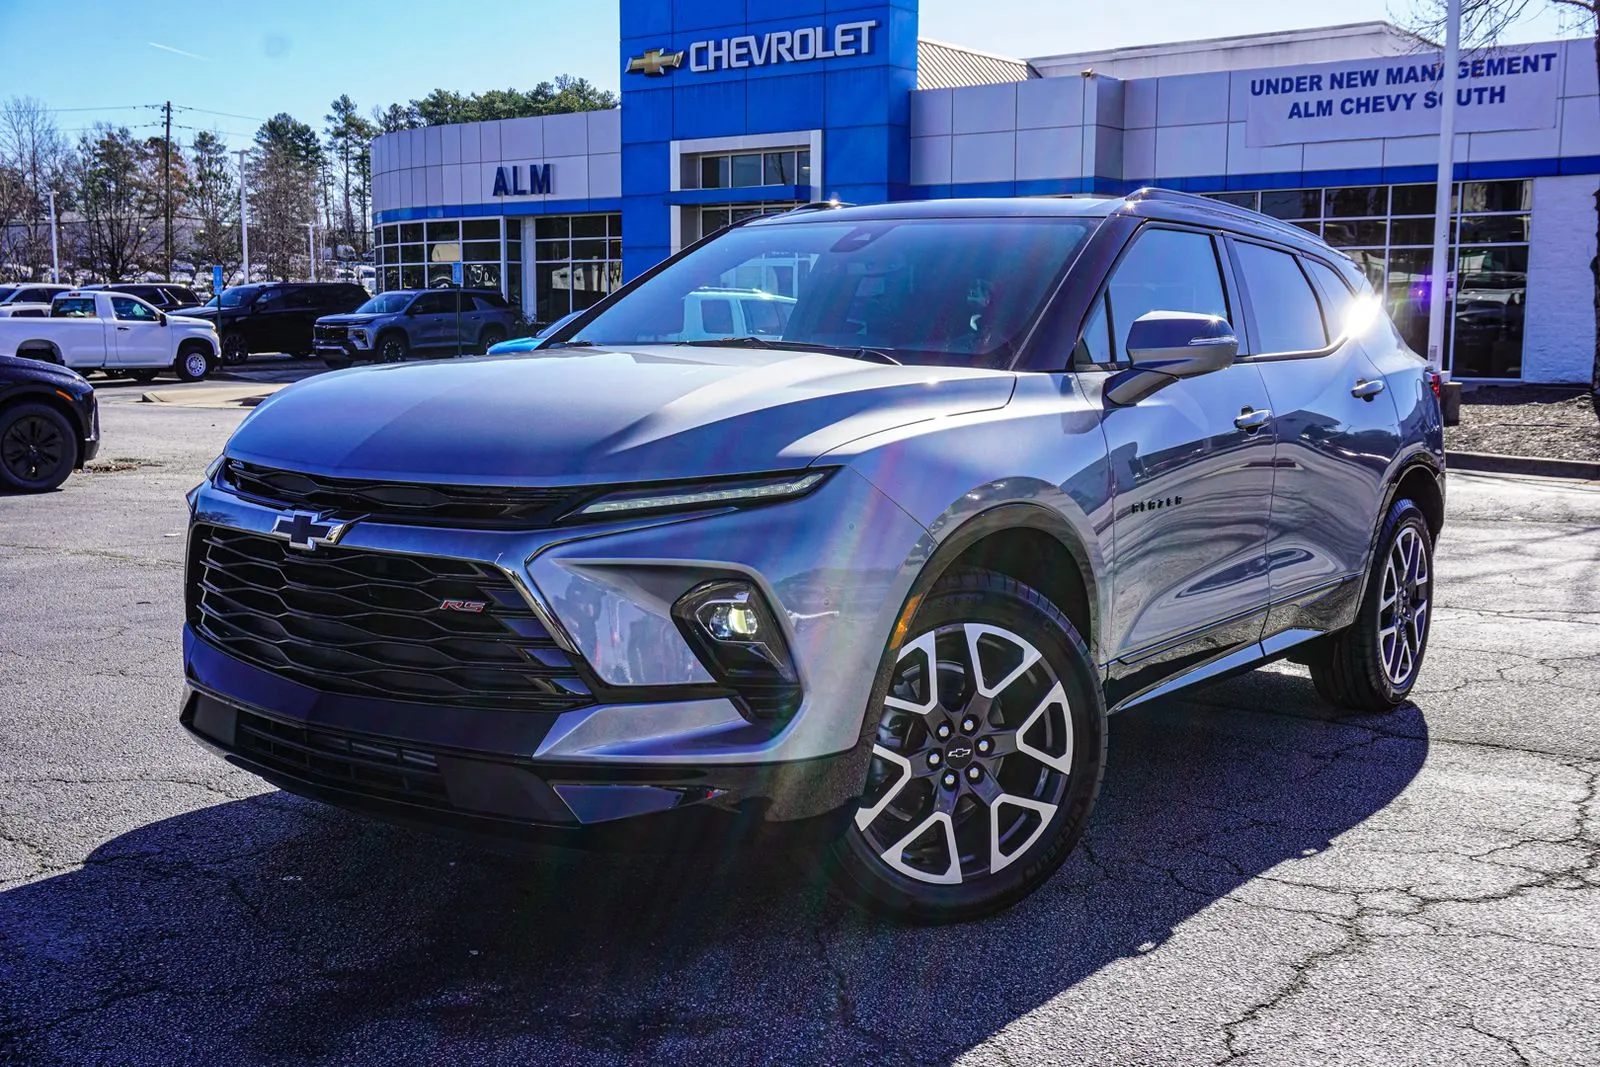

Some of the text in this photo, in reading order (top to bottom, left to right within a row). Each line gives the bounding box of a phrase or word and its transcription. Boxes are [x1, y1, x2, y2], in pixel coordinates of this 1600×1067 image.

[689, 20, 877, 73] CHEVROLET
[1251, 75, 1323, 96] UNDER
[1330, 69, 1379, 90] NEW
[1288, 86, 1506, 119] ALM CHEVY SUTH
[492, 164, 554, 197] ALM
[440, 599, 486, 613] RS
